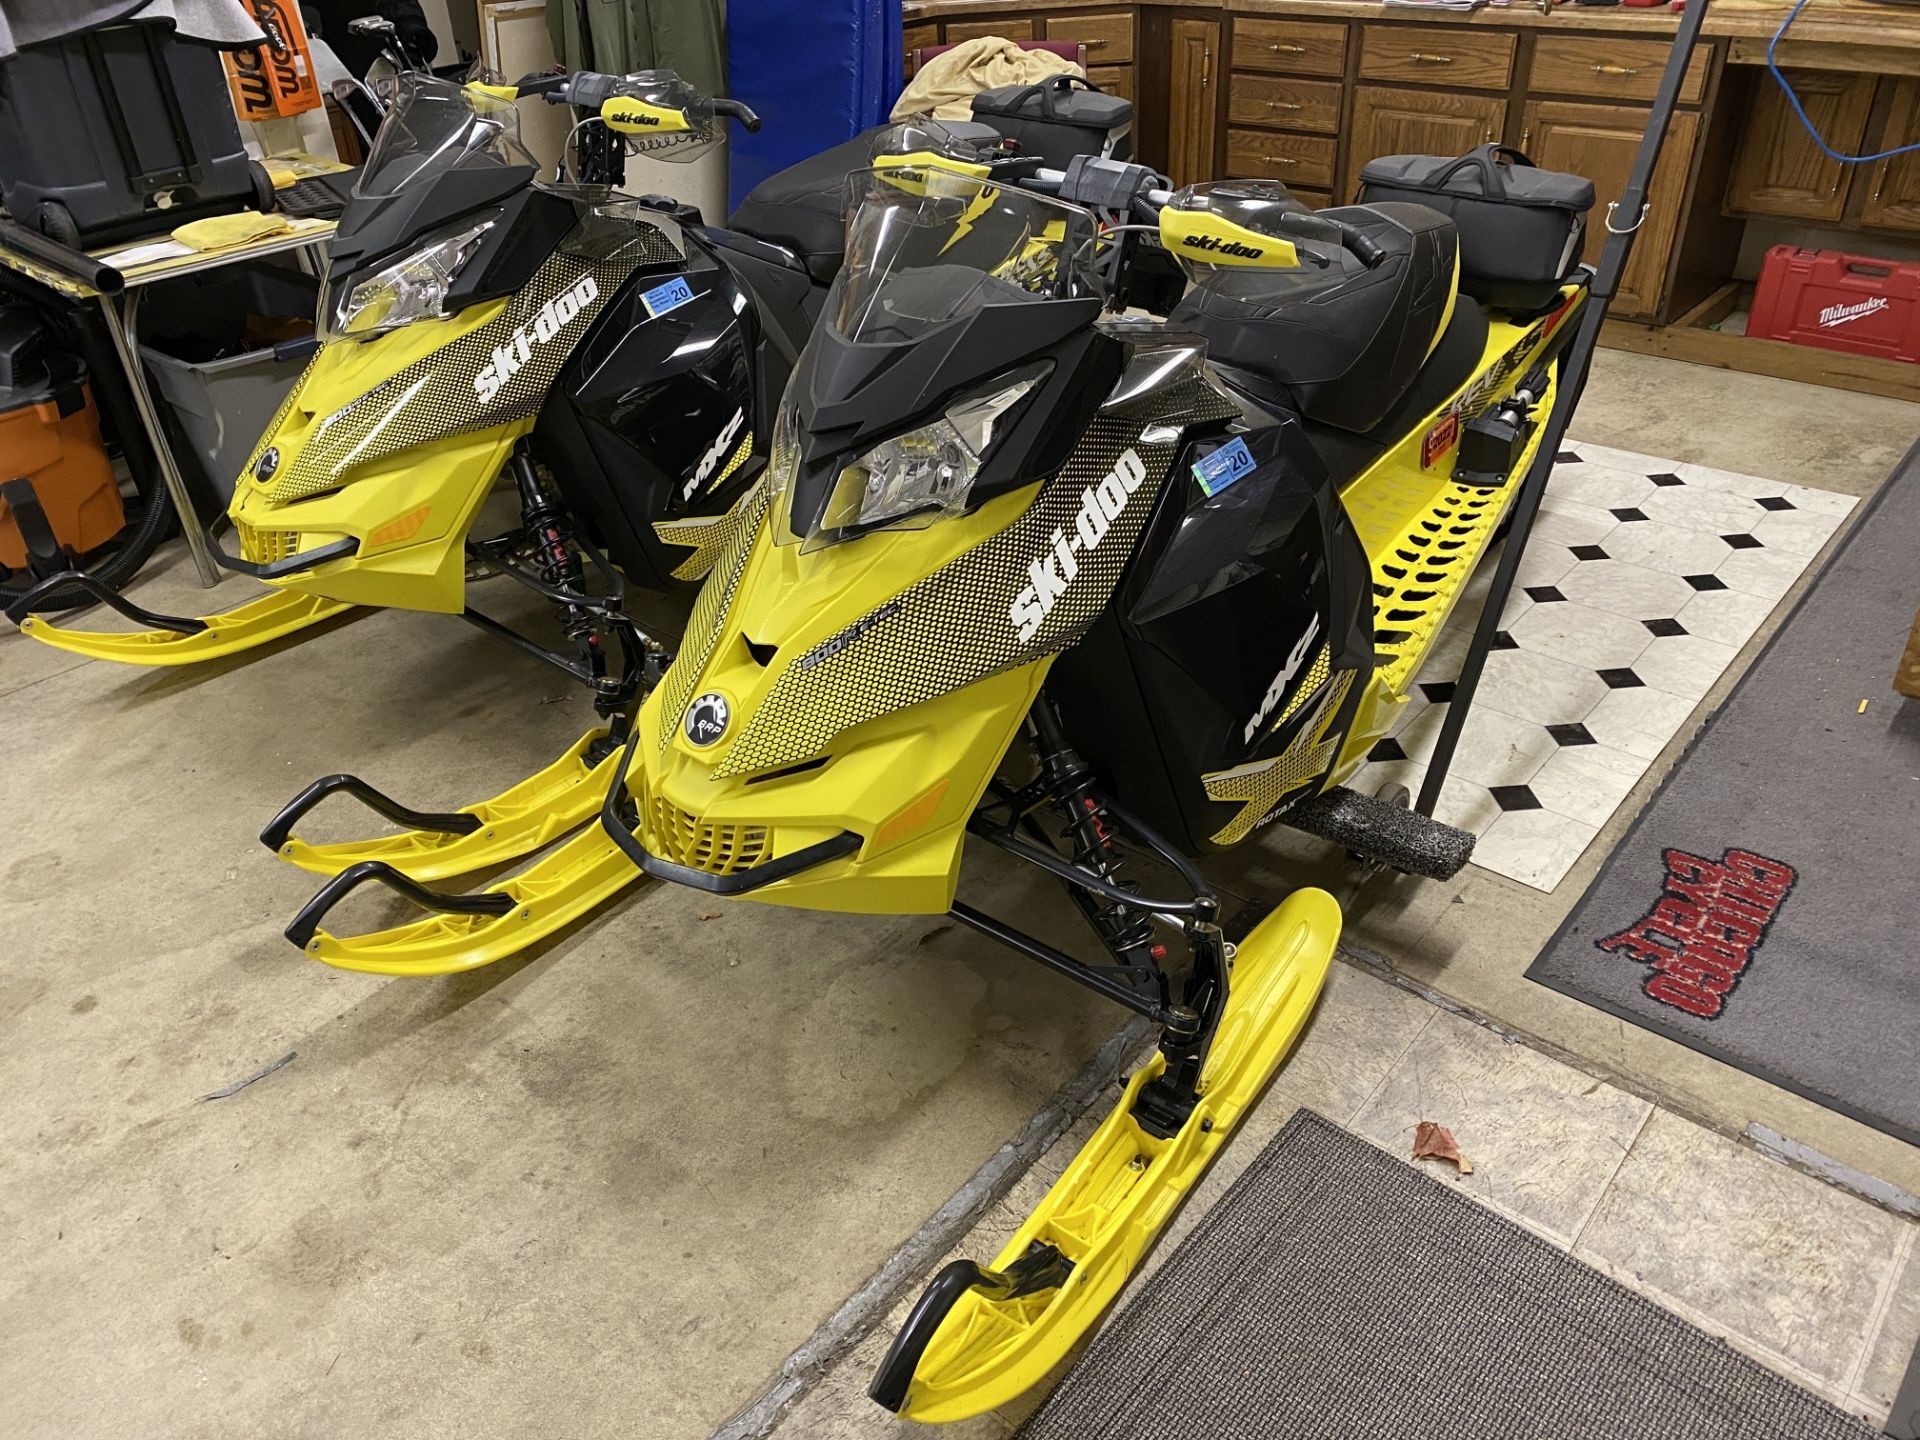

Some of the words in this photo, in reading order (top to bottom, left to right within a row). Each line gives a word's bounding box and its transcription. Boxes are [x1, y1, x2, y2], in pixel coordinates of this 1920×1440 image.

[611, 112, 660, 126] ski-doo
[1182, 235, 1264, 259] ski-doo
[671, 286, 688, 302] 20
[1819, 297, 1888, 324] Milwaukee
[473, 277, 599, 404] ski-doo
[1229, 450, 1249, 472] 20
[1010, 448, 1147, 644] ski-doo
[697, 719, 722, 739] BRP
[1256, 798, 1298, 829] ROTAX
[1597, 848, 1726, 971] CYCLE
[1643, 848, 1797, 1019] CHICAGO
